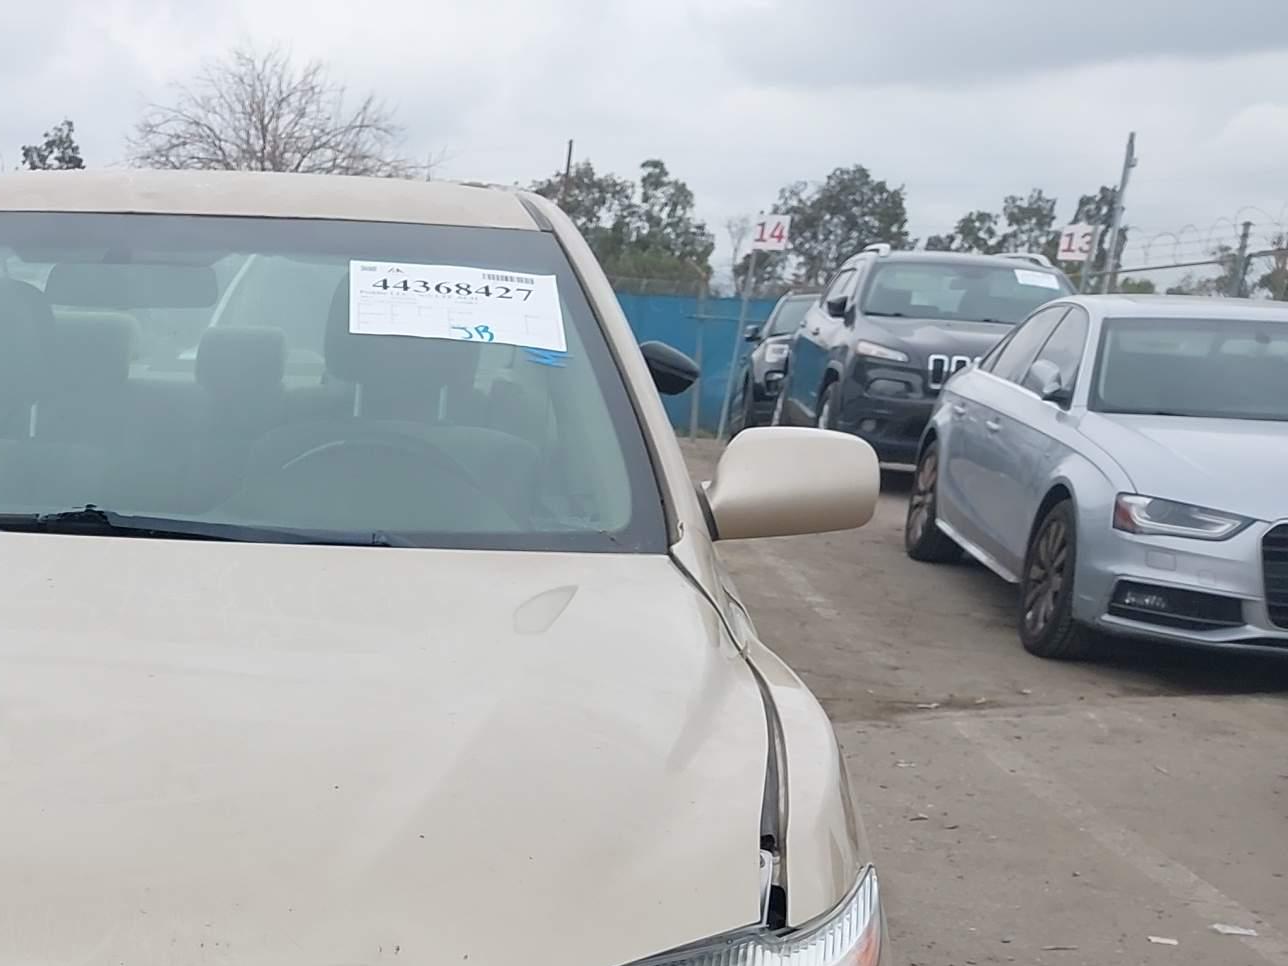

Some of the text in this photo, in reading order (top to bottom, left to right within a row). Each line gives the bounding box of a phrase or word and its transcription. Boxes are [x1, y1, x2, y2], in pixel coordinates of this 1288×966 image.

[754, 221, 785, 243] 14
[1062, 232, 1092, 253] 13
[372, 278, 535, 301] 44368427
